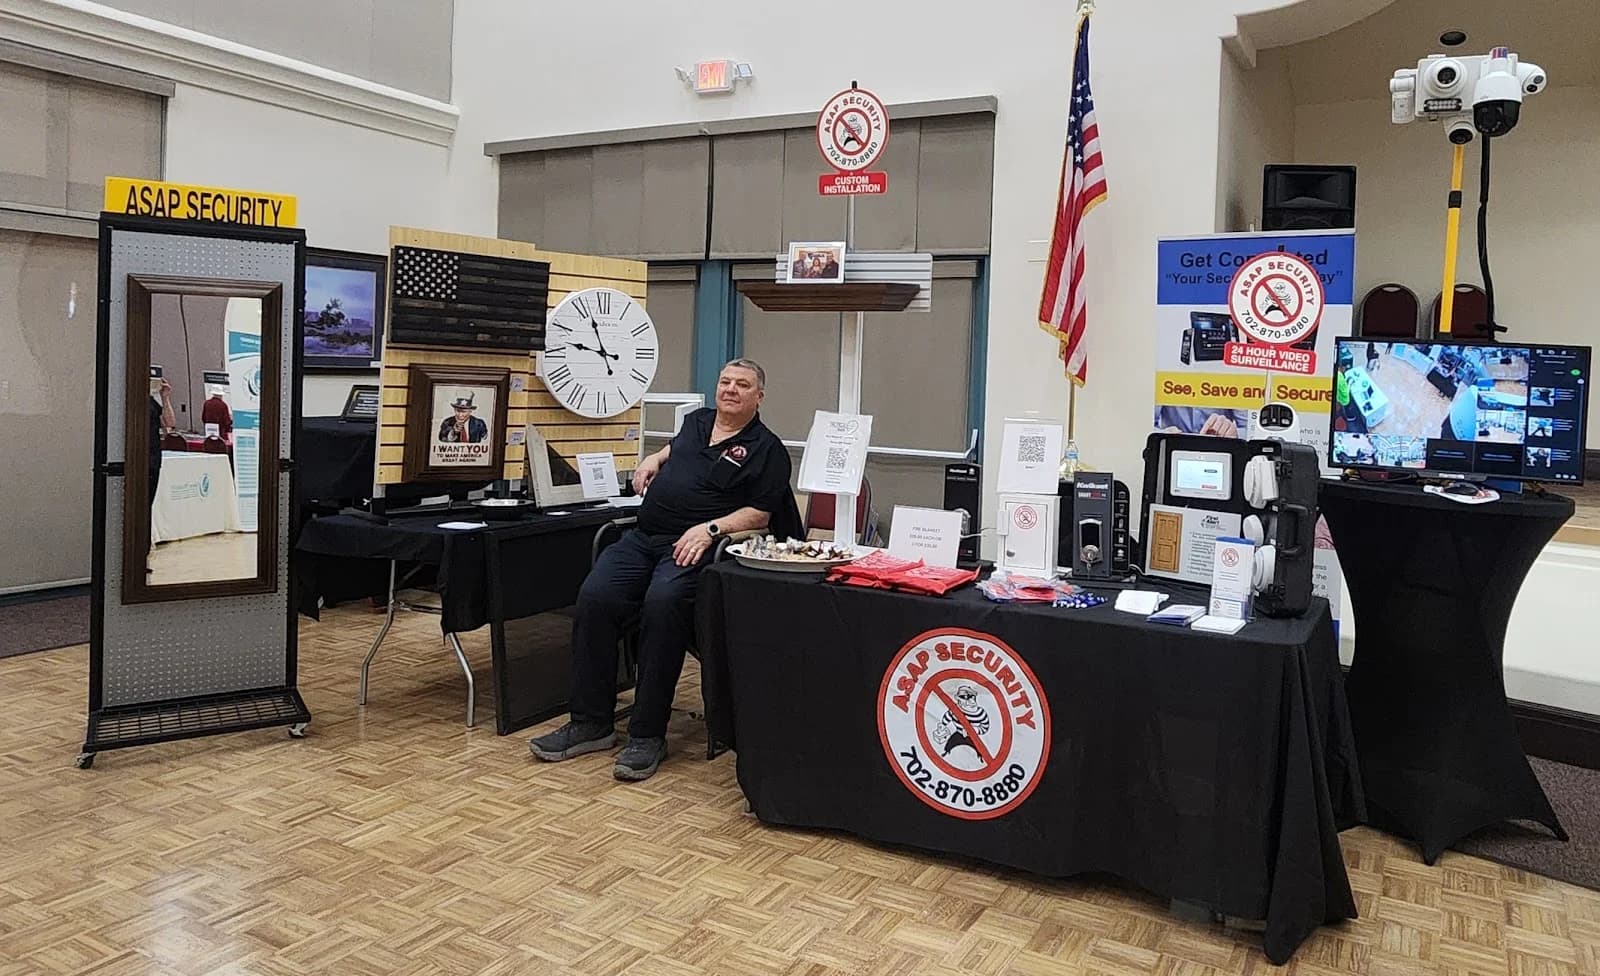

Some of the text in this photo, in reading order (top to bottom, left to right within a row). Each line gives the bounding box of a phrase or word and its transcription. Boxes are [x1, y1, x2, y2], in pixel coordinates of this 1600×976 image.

[824, 96, 881, 133] ASAP SECURITY
[826, 141, 878, 167] 702-870-8880
[824, 184, 881, 194] INSTALLATION
[834, 176, 869, 185] CUSTOM
[125, 185, 283, 227] ASAP SECURITY
[1180, 252, 1212, 268] Get
[1240, 261, 1315, 305] ASAP SECURITY
[1241, 310, 1309, 339] 702-870-8880
[1230, 354, 1309, 372] SURVEILLANCE
[1231, 346, 1310, 362] 24 HOUR VIDEO
[1163, 381, 1333, 402] See, Save an Secure
[433, 445, 488, 454] I WANT YOU
[892, 642, 1036, 730] ASAP SECURITY
[900, 746, 1026, 807] 702-870-8880
